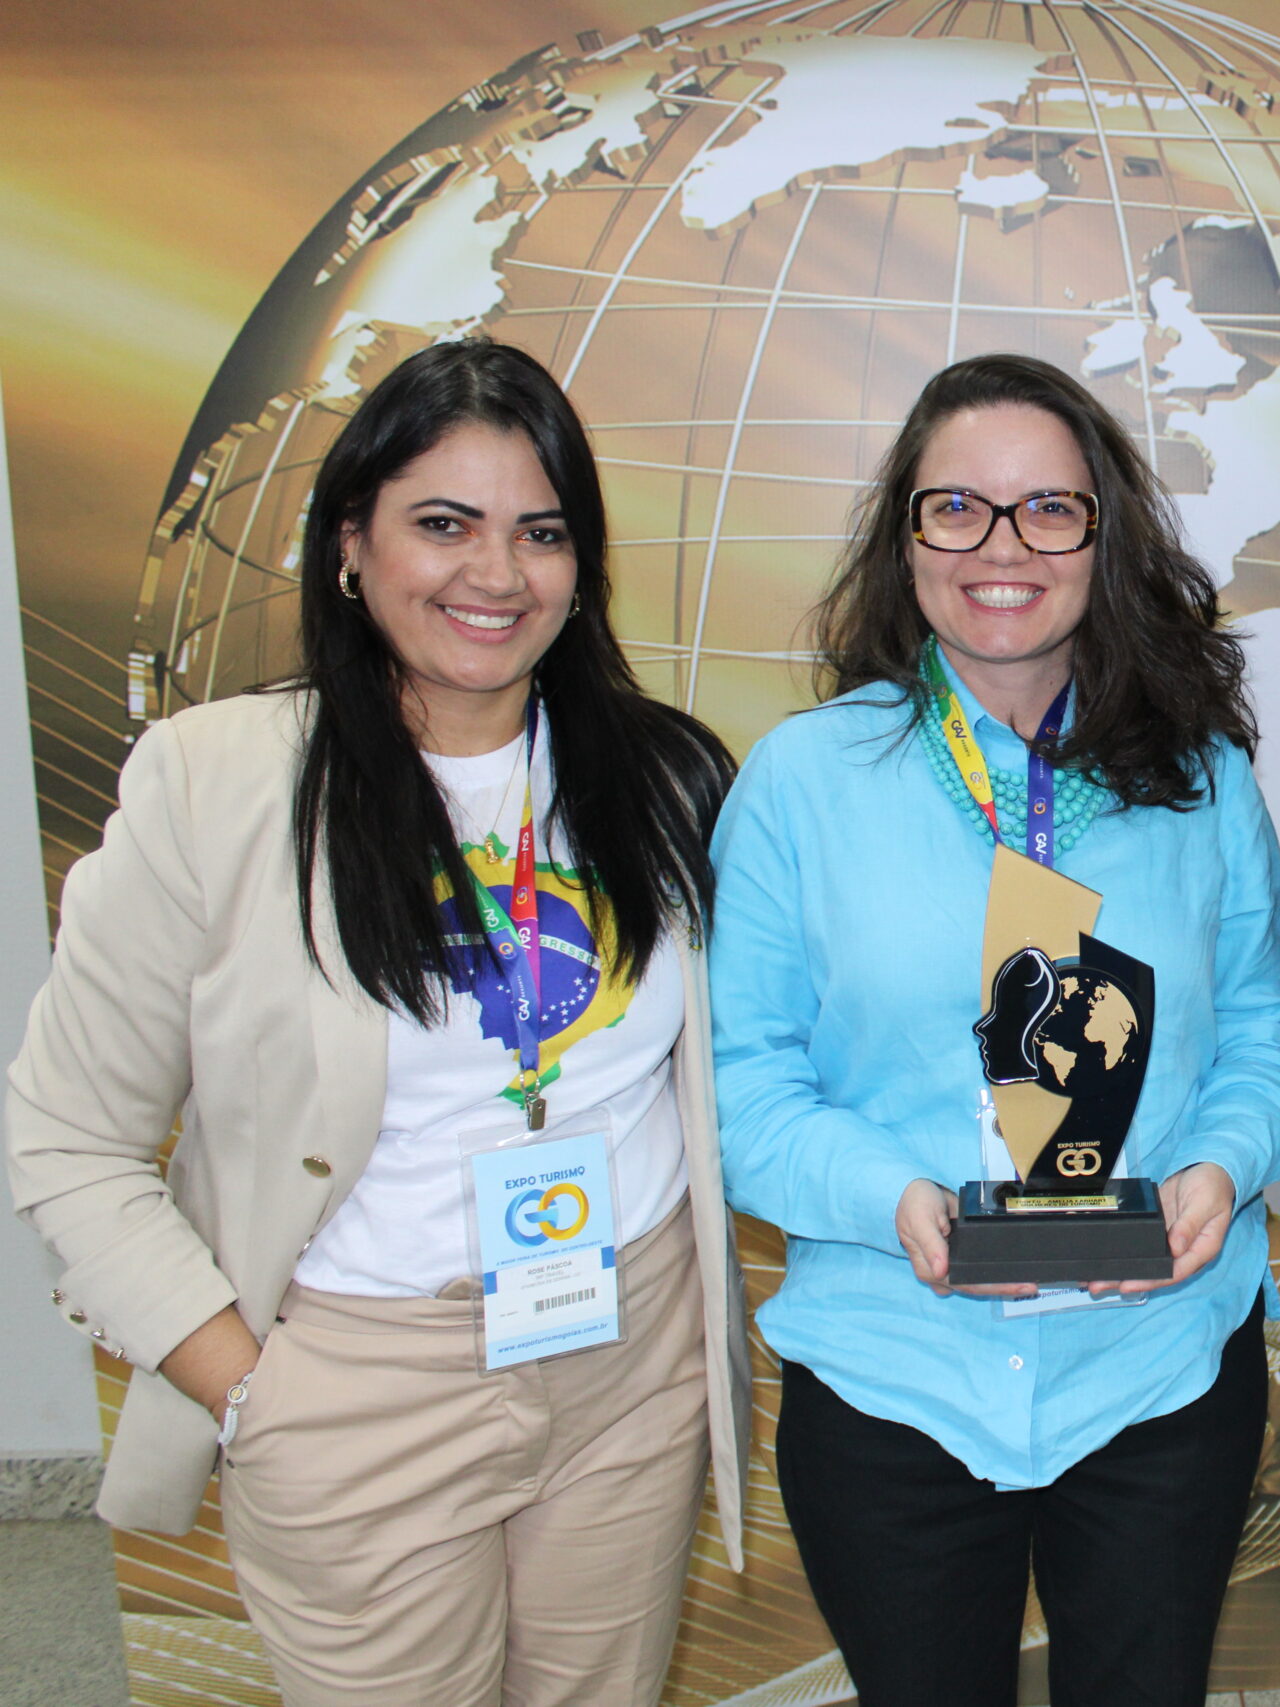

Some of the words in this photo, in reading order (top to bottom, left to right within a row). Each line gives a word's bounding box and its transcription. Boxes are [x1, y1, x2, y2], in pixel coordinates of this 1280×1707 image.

[1035, 832, 1047, 854] GAV
[540, 936, 594, 965] GRESSO
[518, 998, 530, 1021] GAV
[505, 1176, 536, 1190] EXPO
[539, 1166, 586, 1184] TURISMO
